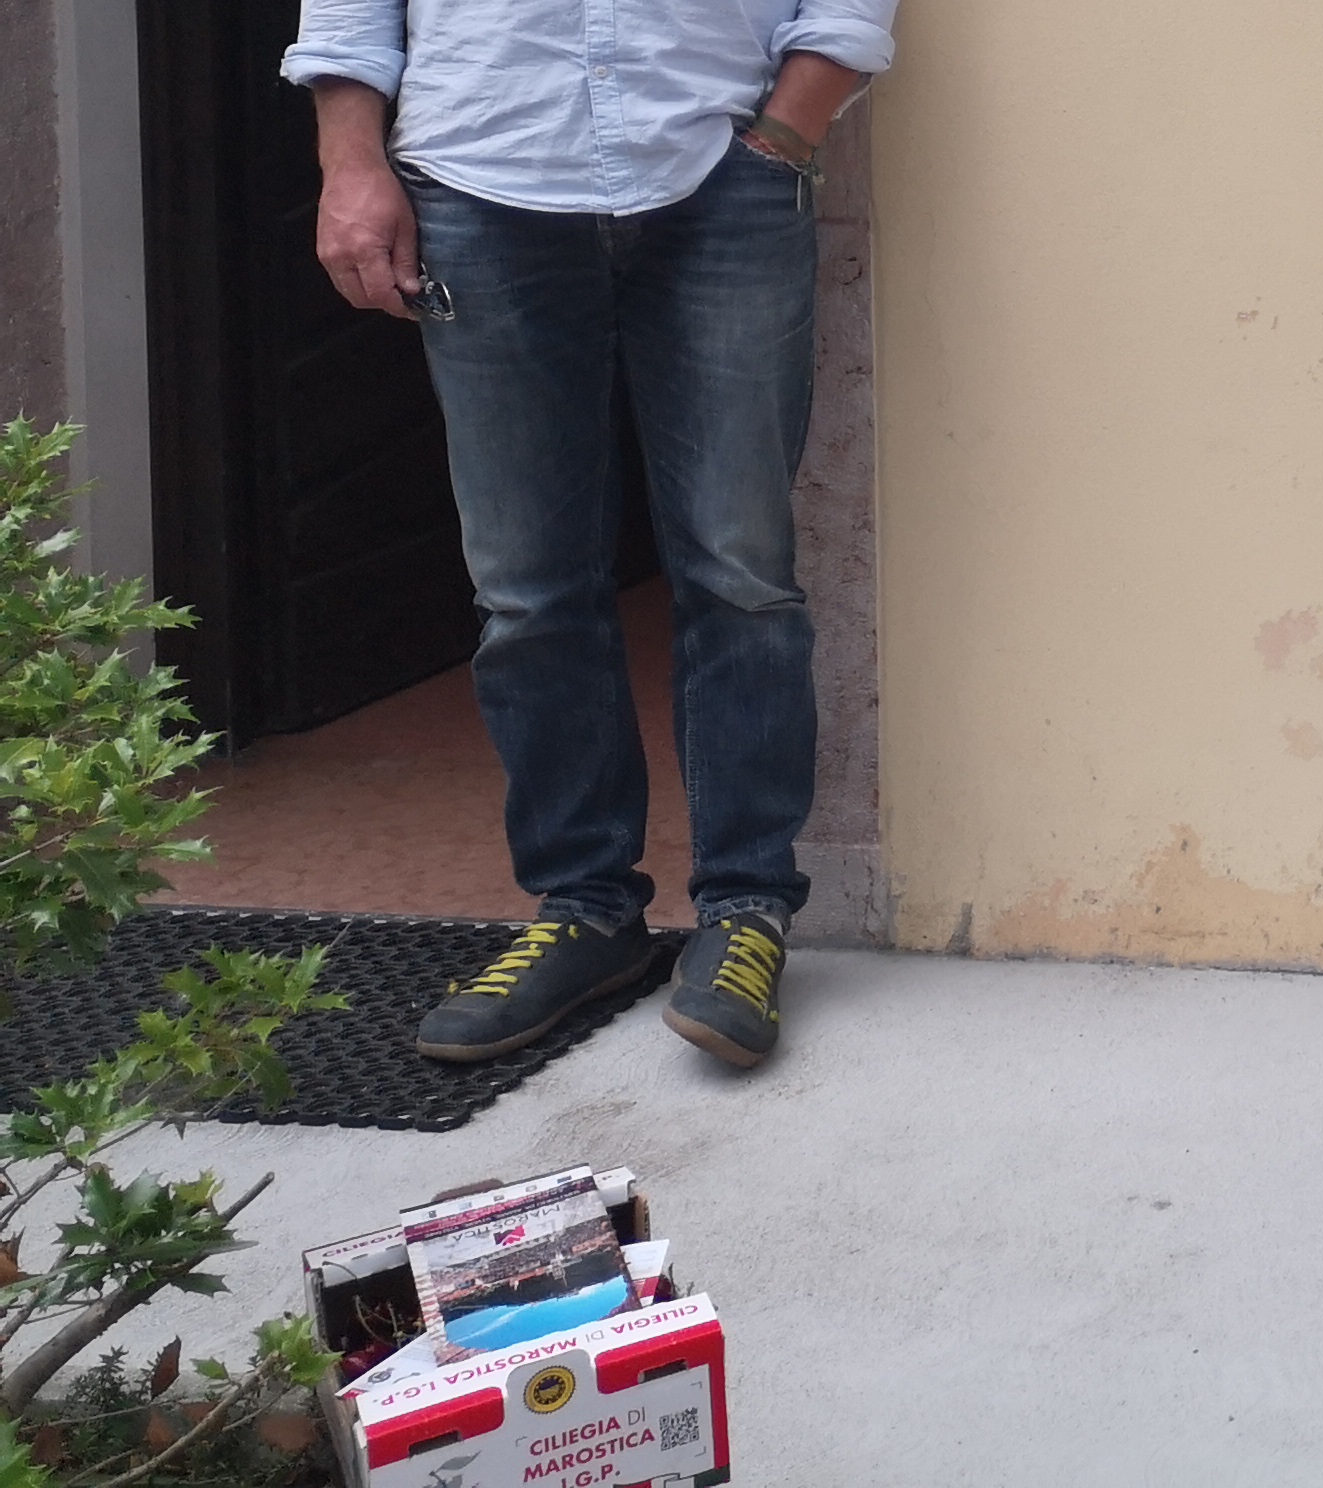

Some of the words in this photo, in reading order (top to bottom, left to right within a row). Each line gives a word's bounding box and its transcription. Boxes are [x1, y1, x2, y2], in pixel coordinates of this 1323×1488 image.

[452, 1204, 561, 1242] MAROSTICA
[586, 1329, 604, 1343] DI
[610, 1304, 698, 1335] CILIEGIA
[443, 1337, 577, 1386] MAROSTICA
[373, 1380, 436, 1407] I.G.P.
[530, 1416, 620, 1456] CILIEGIA
[628, 1406, 646, 1426] DI
[523, 1428, 656, 1483] MAROSTICA
[561, 1463, 620, 1488] I.G.P.
